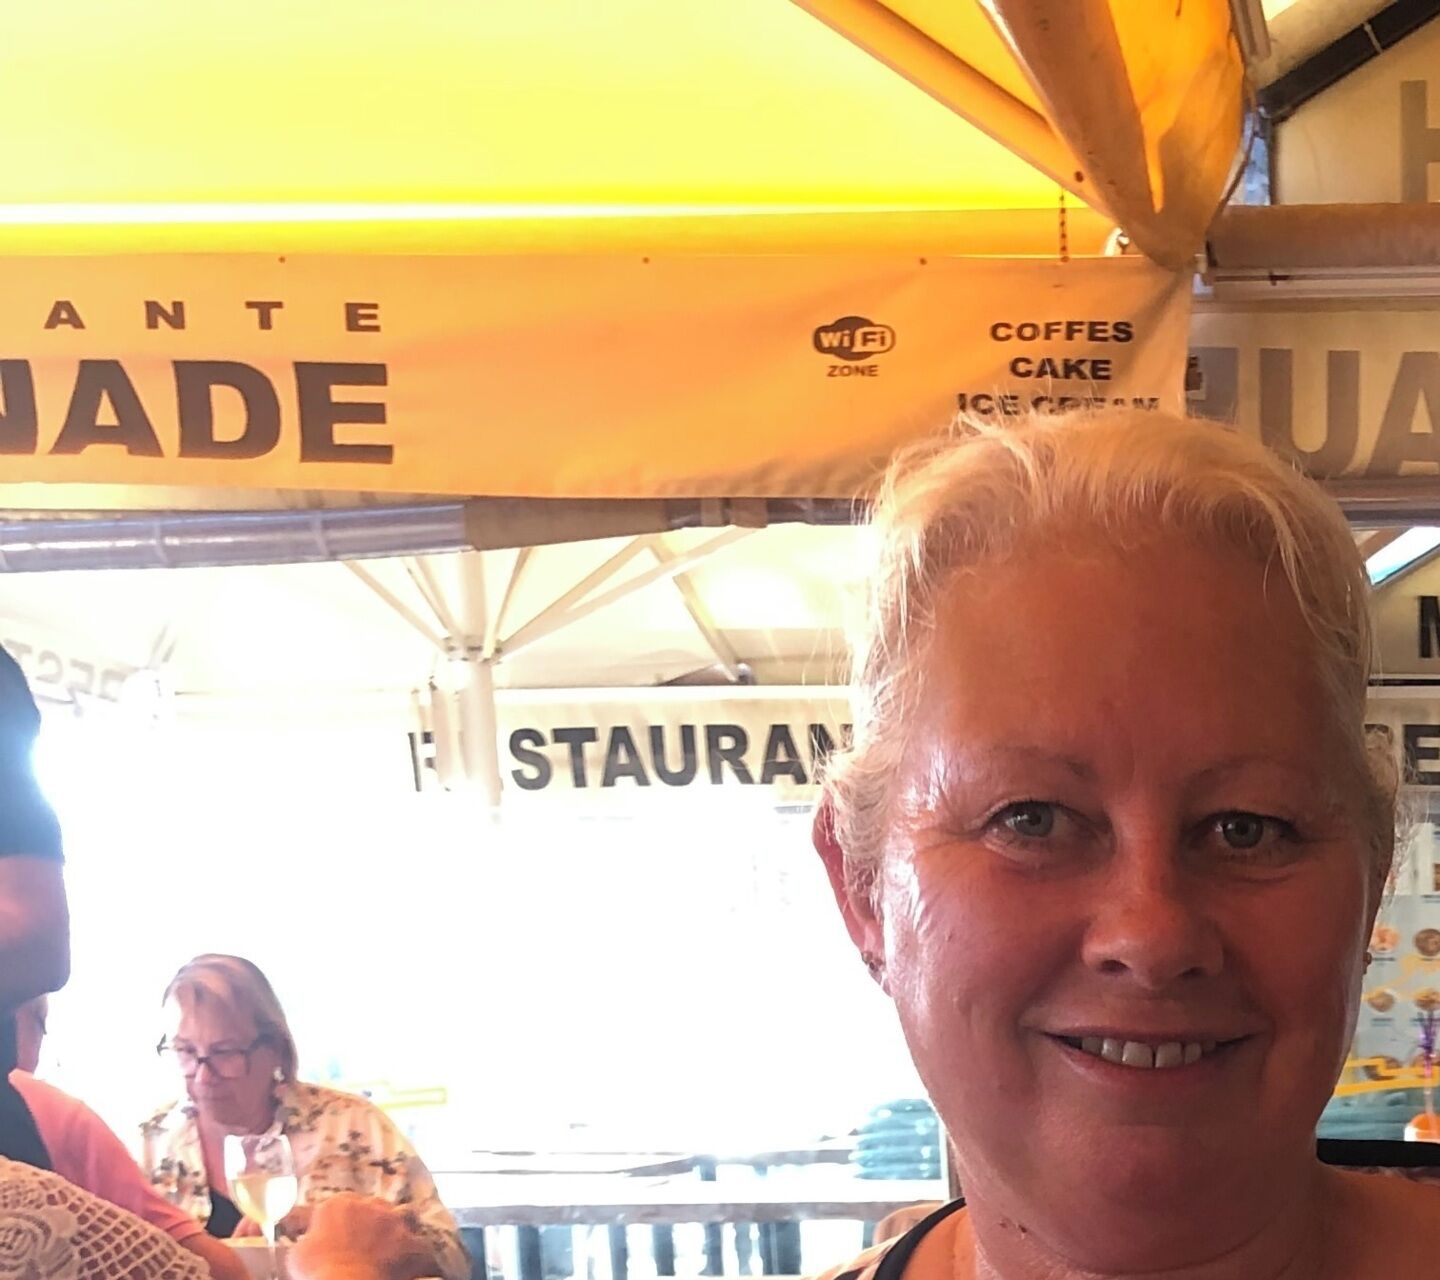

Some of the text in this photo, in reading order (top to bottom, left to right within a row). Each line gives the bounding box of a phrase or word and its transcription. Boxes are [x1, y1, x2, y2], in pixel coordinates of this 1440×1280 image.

[990, 321, 1134, 343] COFFES
[827, 364, 878, 377] ZONE
[1009, 357, 1112, 380] CAKE
[957, 392, 1020, 415] ICE
